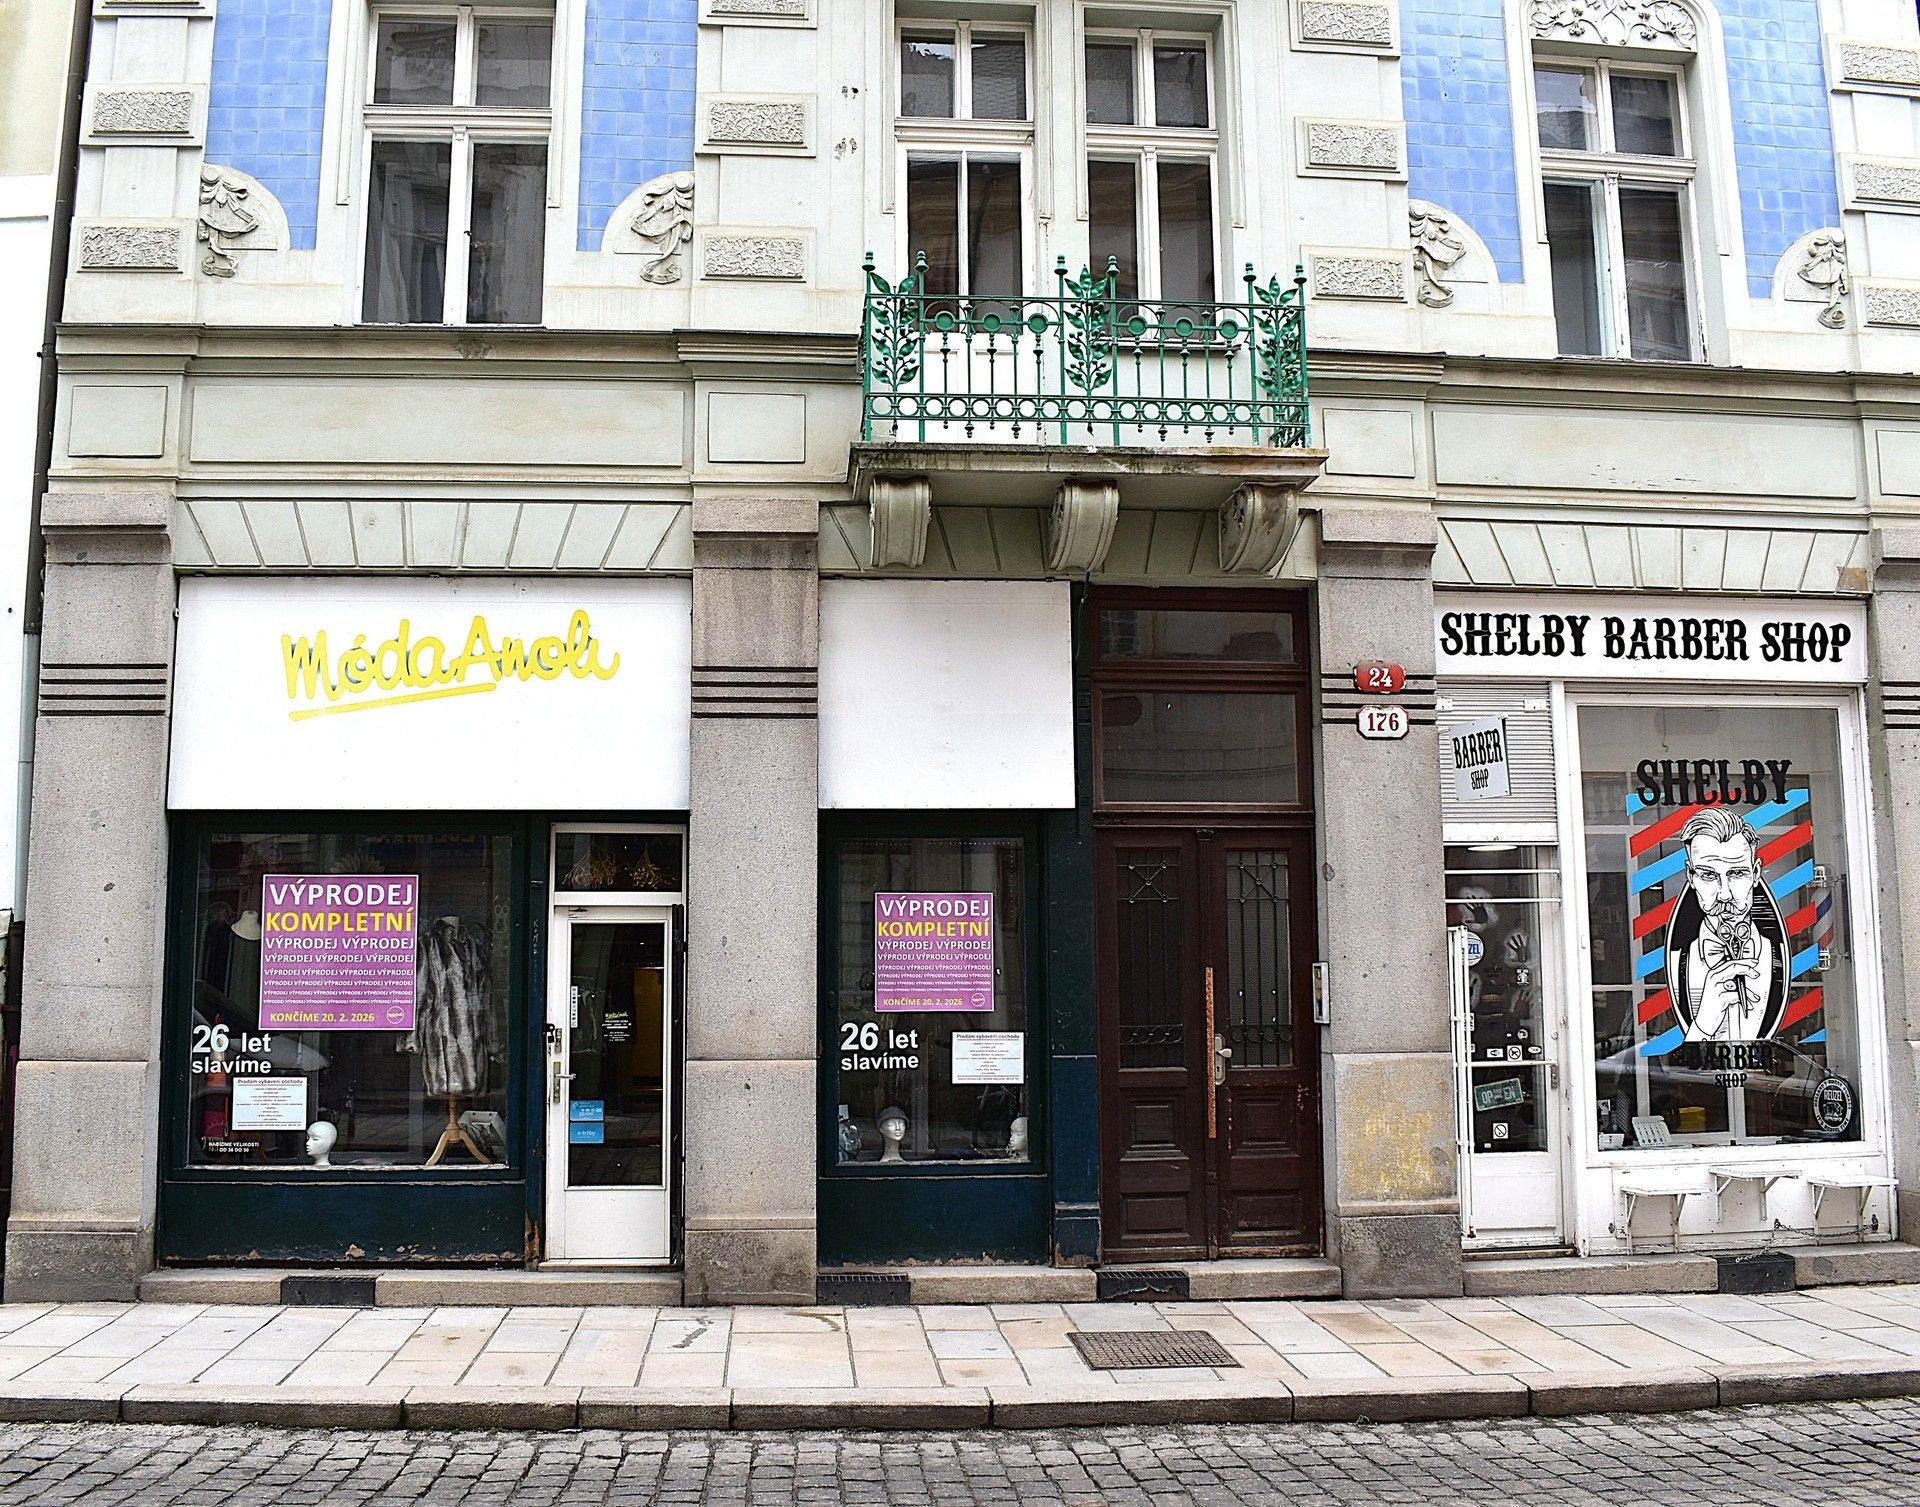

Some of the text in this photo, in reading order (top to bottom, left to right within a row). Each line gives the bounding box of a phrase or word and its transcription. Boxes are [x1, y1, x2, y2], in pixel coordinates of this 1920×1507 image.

[1440, 612, 1851, 662] SHELBY BARBER SHOP
[1369, 667, 1392, 687] 24
[1368, 713, 1399, 731] 176
[1452, 728, 1503, 769] BARBER
[1471, 768, 1489, 790] SHOP
[1635, 759, 1792, 806] SHELBY
[269, 878, 413, 906] VÝPRODEJ
[880, 896, 989, 917] VÝPRODEJ
[266, 907, 414, 932] KOMPLETNÍ
[878, 917, 989, 936] KOMPLETNÍ
[265, 935, 414, 949] VÝPRODEJ VÝPRODEJ
[878, 939, 990, 950] VÝPRODEJ VÝPRODEJ
[265, 952, 414, 962] VÝPRODEJ VÝPRODEJ VÝPRODEJ
[878, 952, 991, 960] VÝPRODEJ VÝPRODEJ VÝPRODEJ
[883, 997, 921, 1005] KONČÍME
[270, 1012, 375, 1022] KONČÍME 20. 2. 2026
[192, 1024, 272, 1053] 26 let
[840, 1022, 918, 1051] 26 let
[191, 1056, 272, 1073] slavíme
[841, 1052, 919, 1070] slavíme
[1687, 1042, 1774, 1070] BARBER
[1715, 1073, 1747, 1087] SHOP
